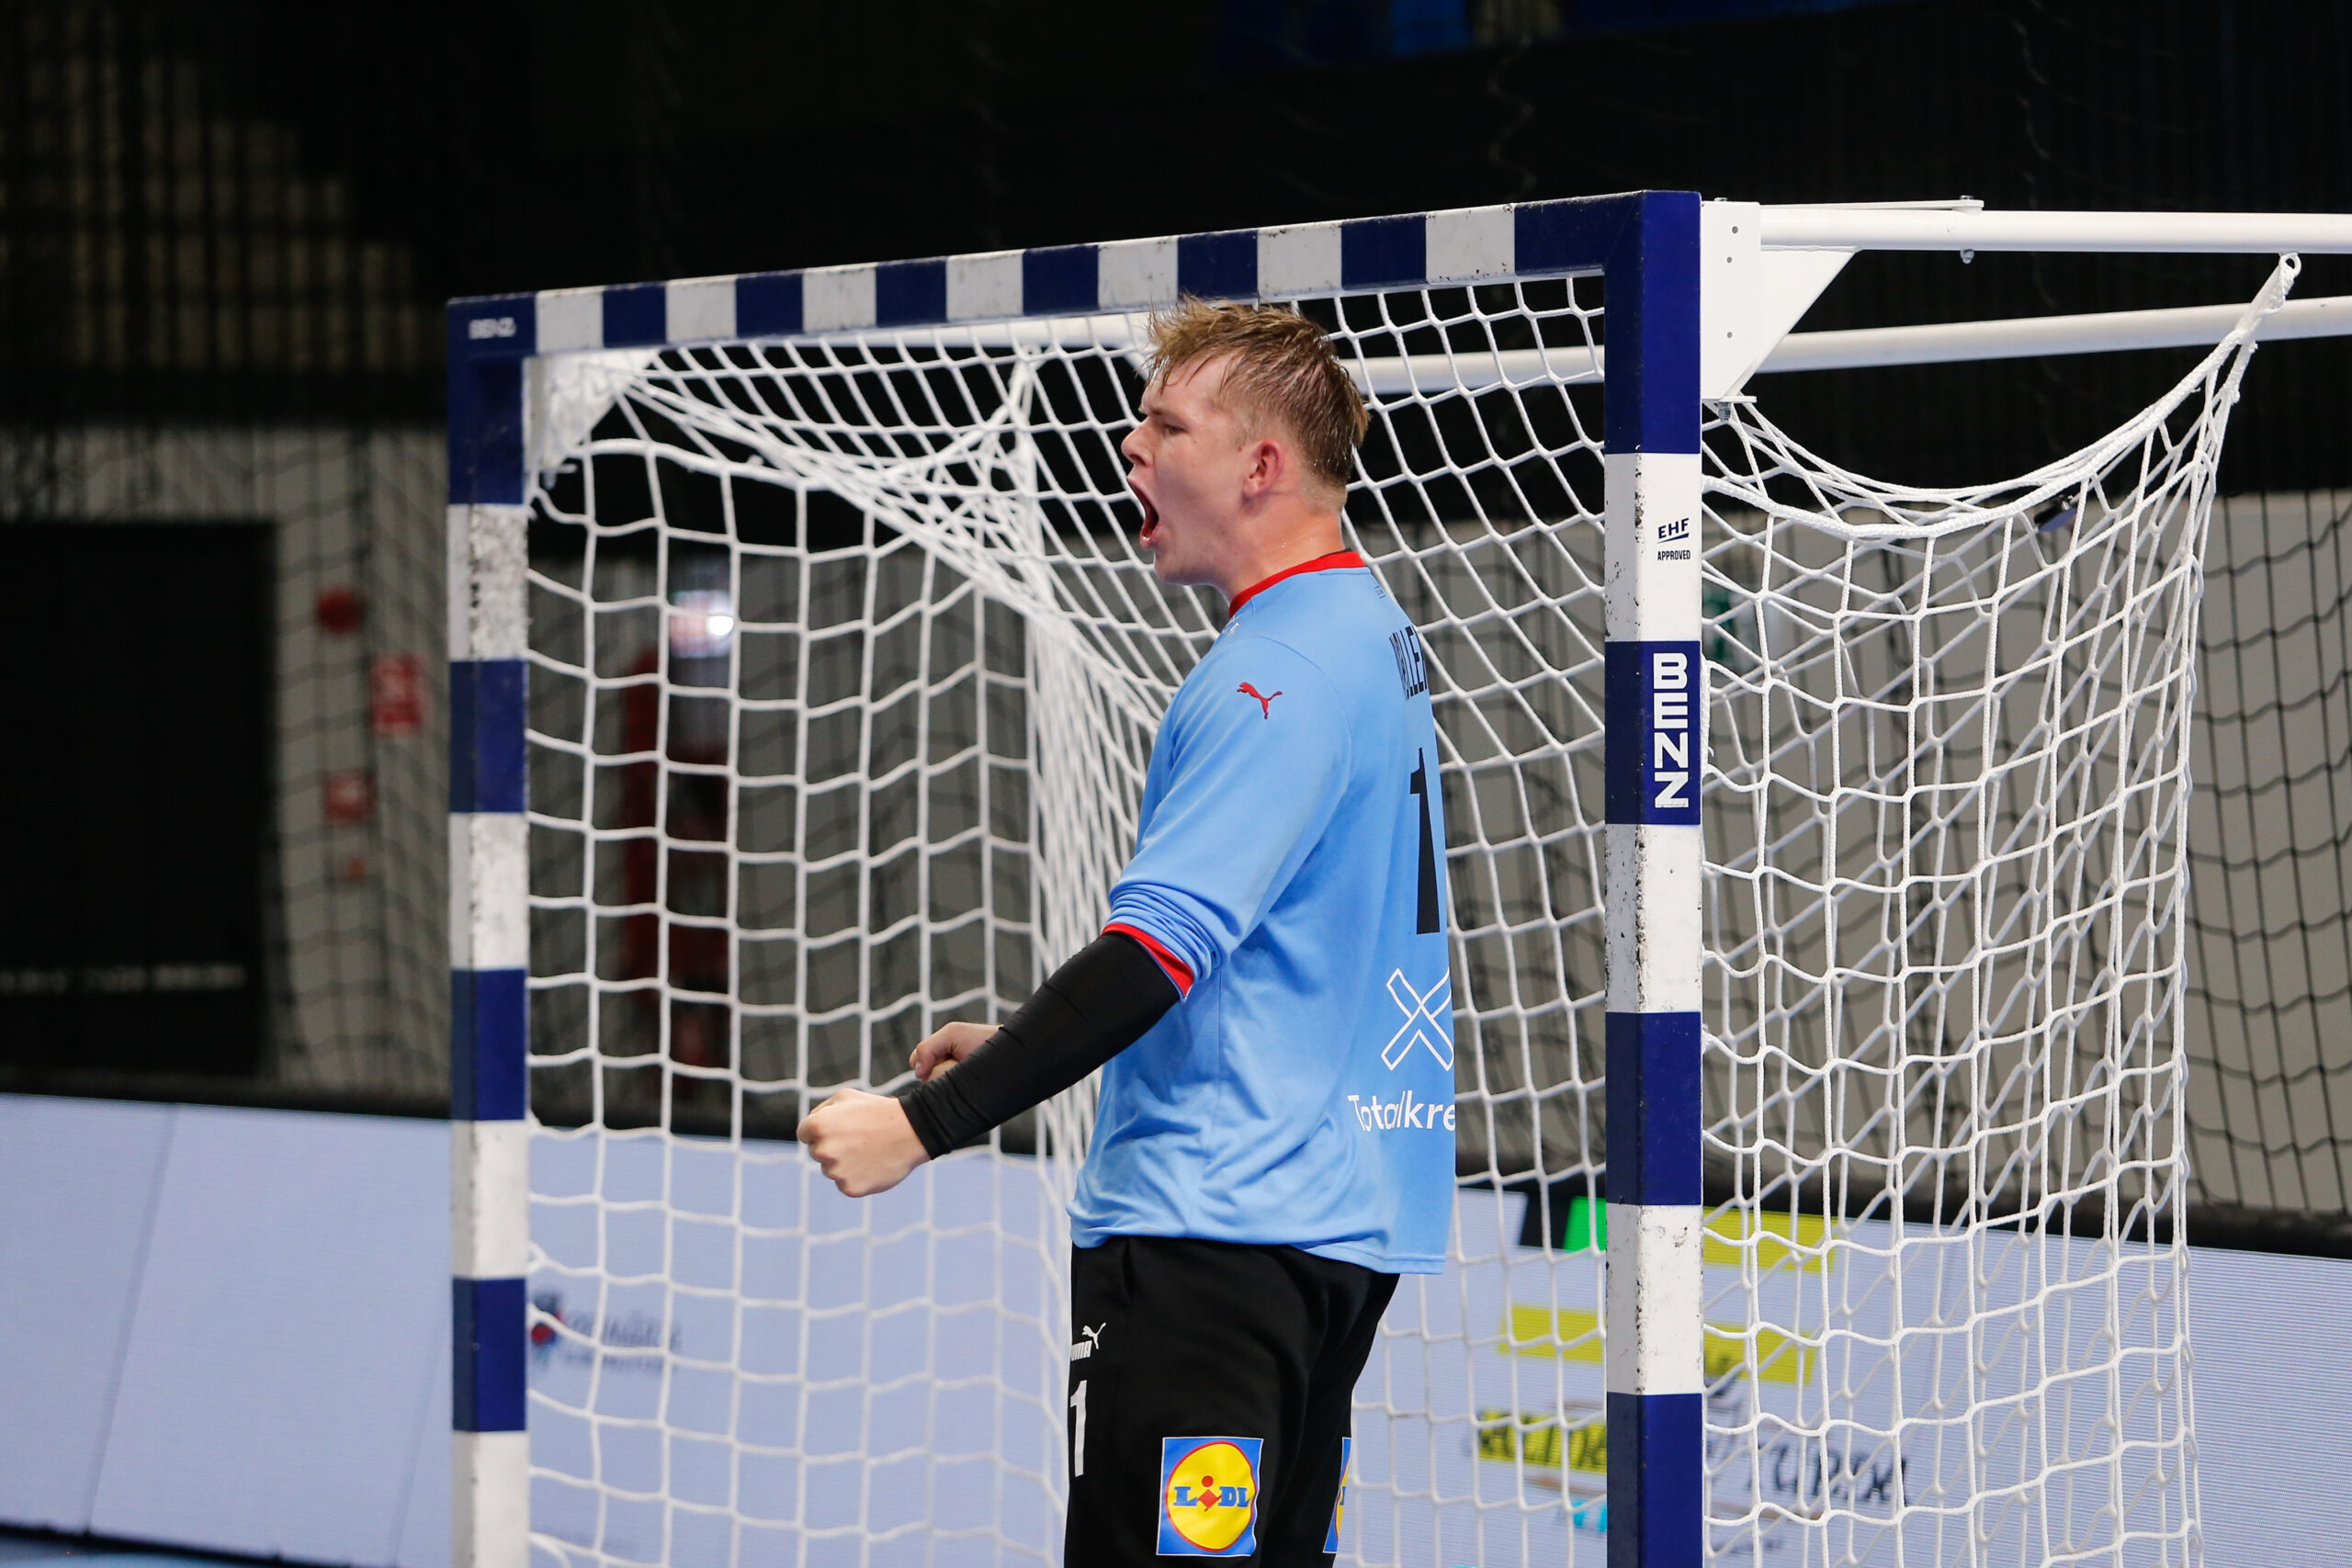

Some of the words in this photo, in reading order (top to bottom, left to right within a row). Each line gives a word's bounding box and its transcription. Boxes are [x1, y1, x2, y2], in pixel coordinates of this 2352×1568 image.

[1657, 517, 1690, 539] EHF
[1657, 549, 1690, 560] APPROVED
[1654, 653, 1690, 807] BENZ
